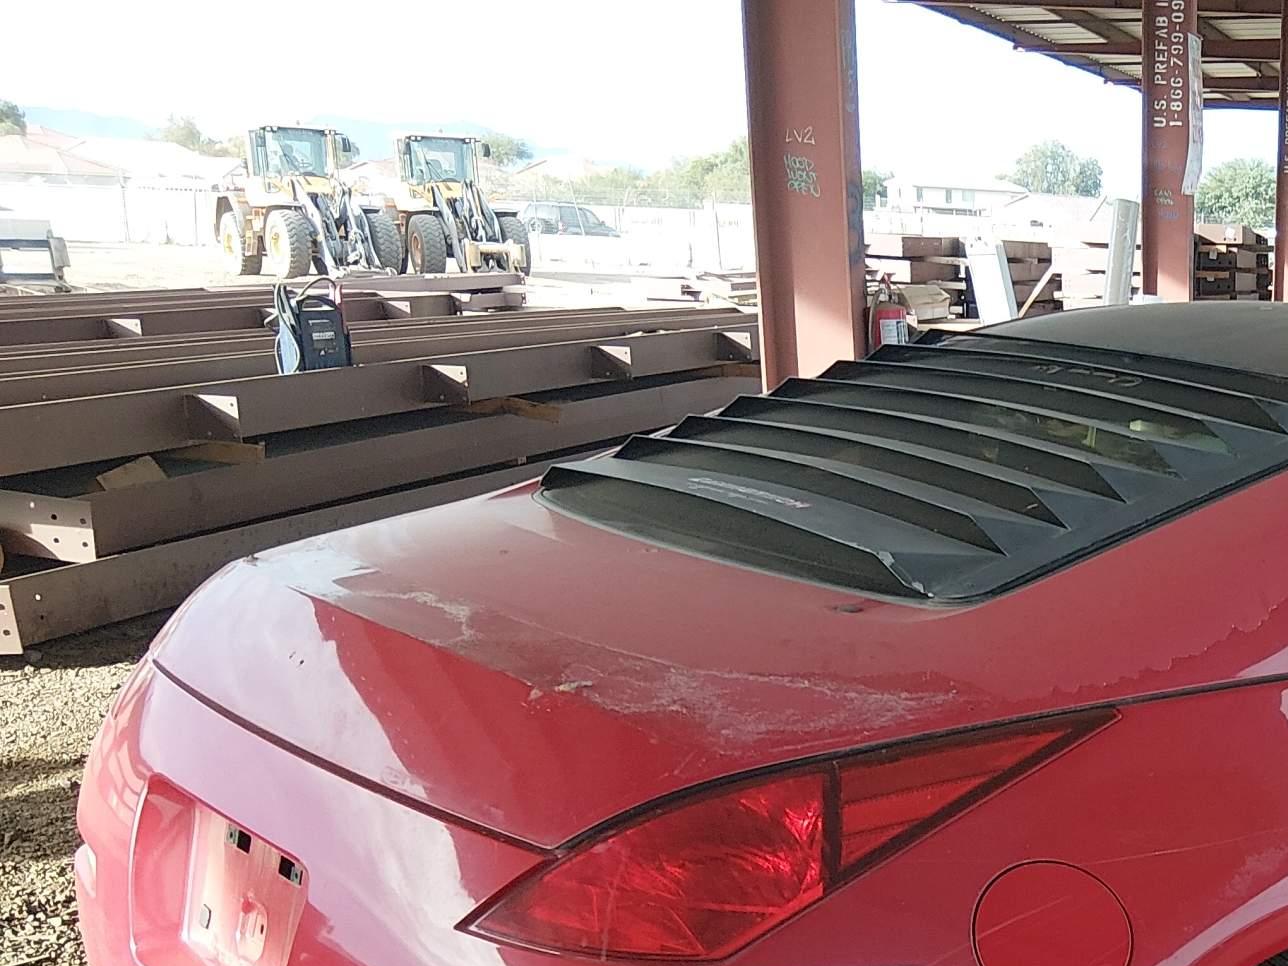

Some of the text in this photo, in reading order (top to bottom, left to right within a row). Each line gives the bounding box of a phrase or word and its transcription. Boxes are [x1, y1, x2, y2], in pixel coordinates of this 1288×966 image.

[1154, 16, 1169, 85] PREFAB
[1153, 94, 1167, 127] U.S.
[785, 126, 816, 145] LV2
